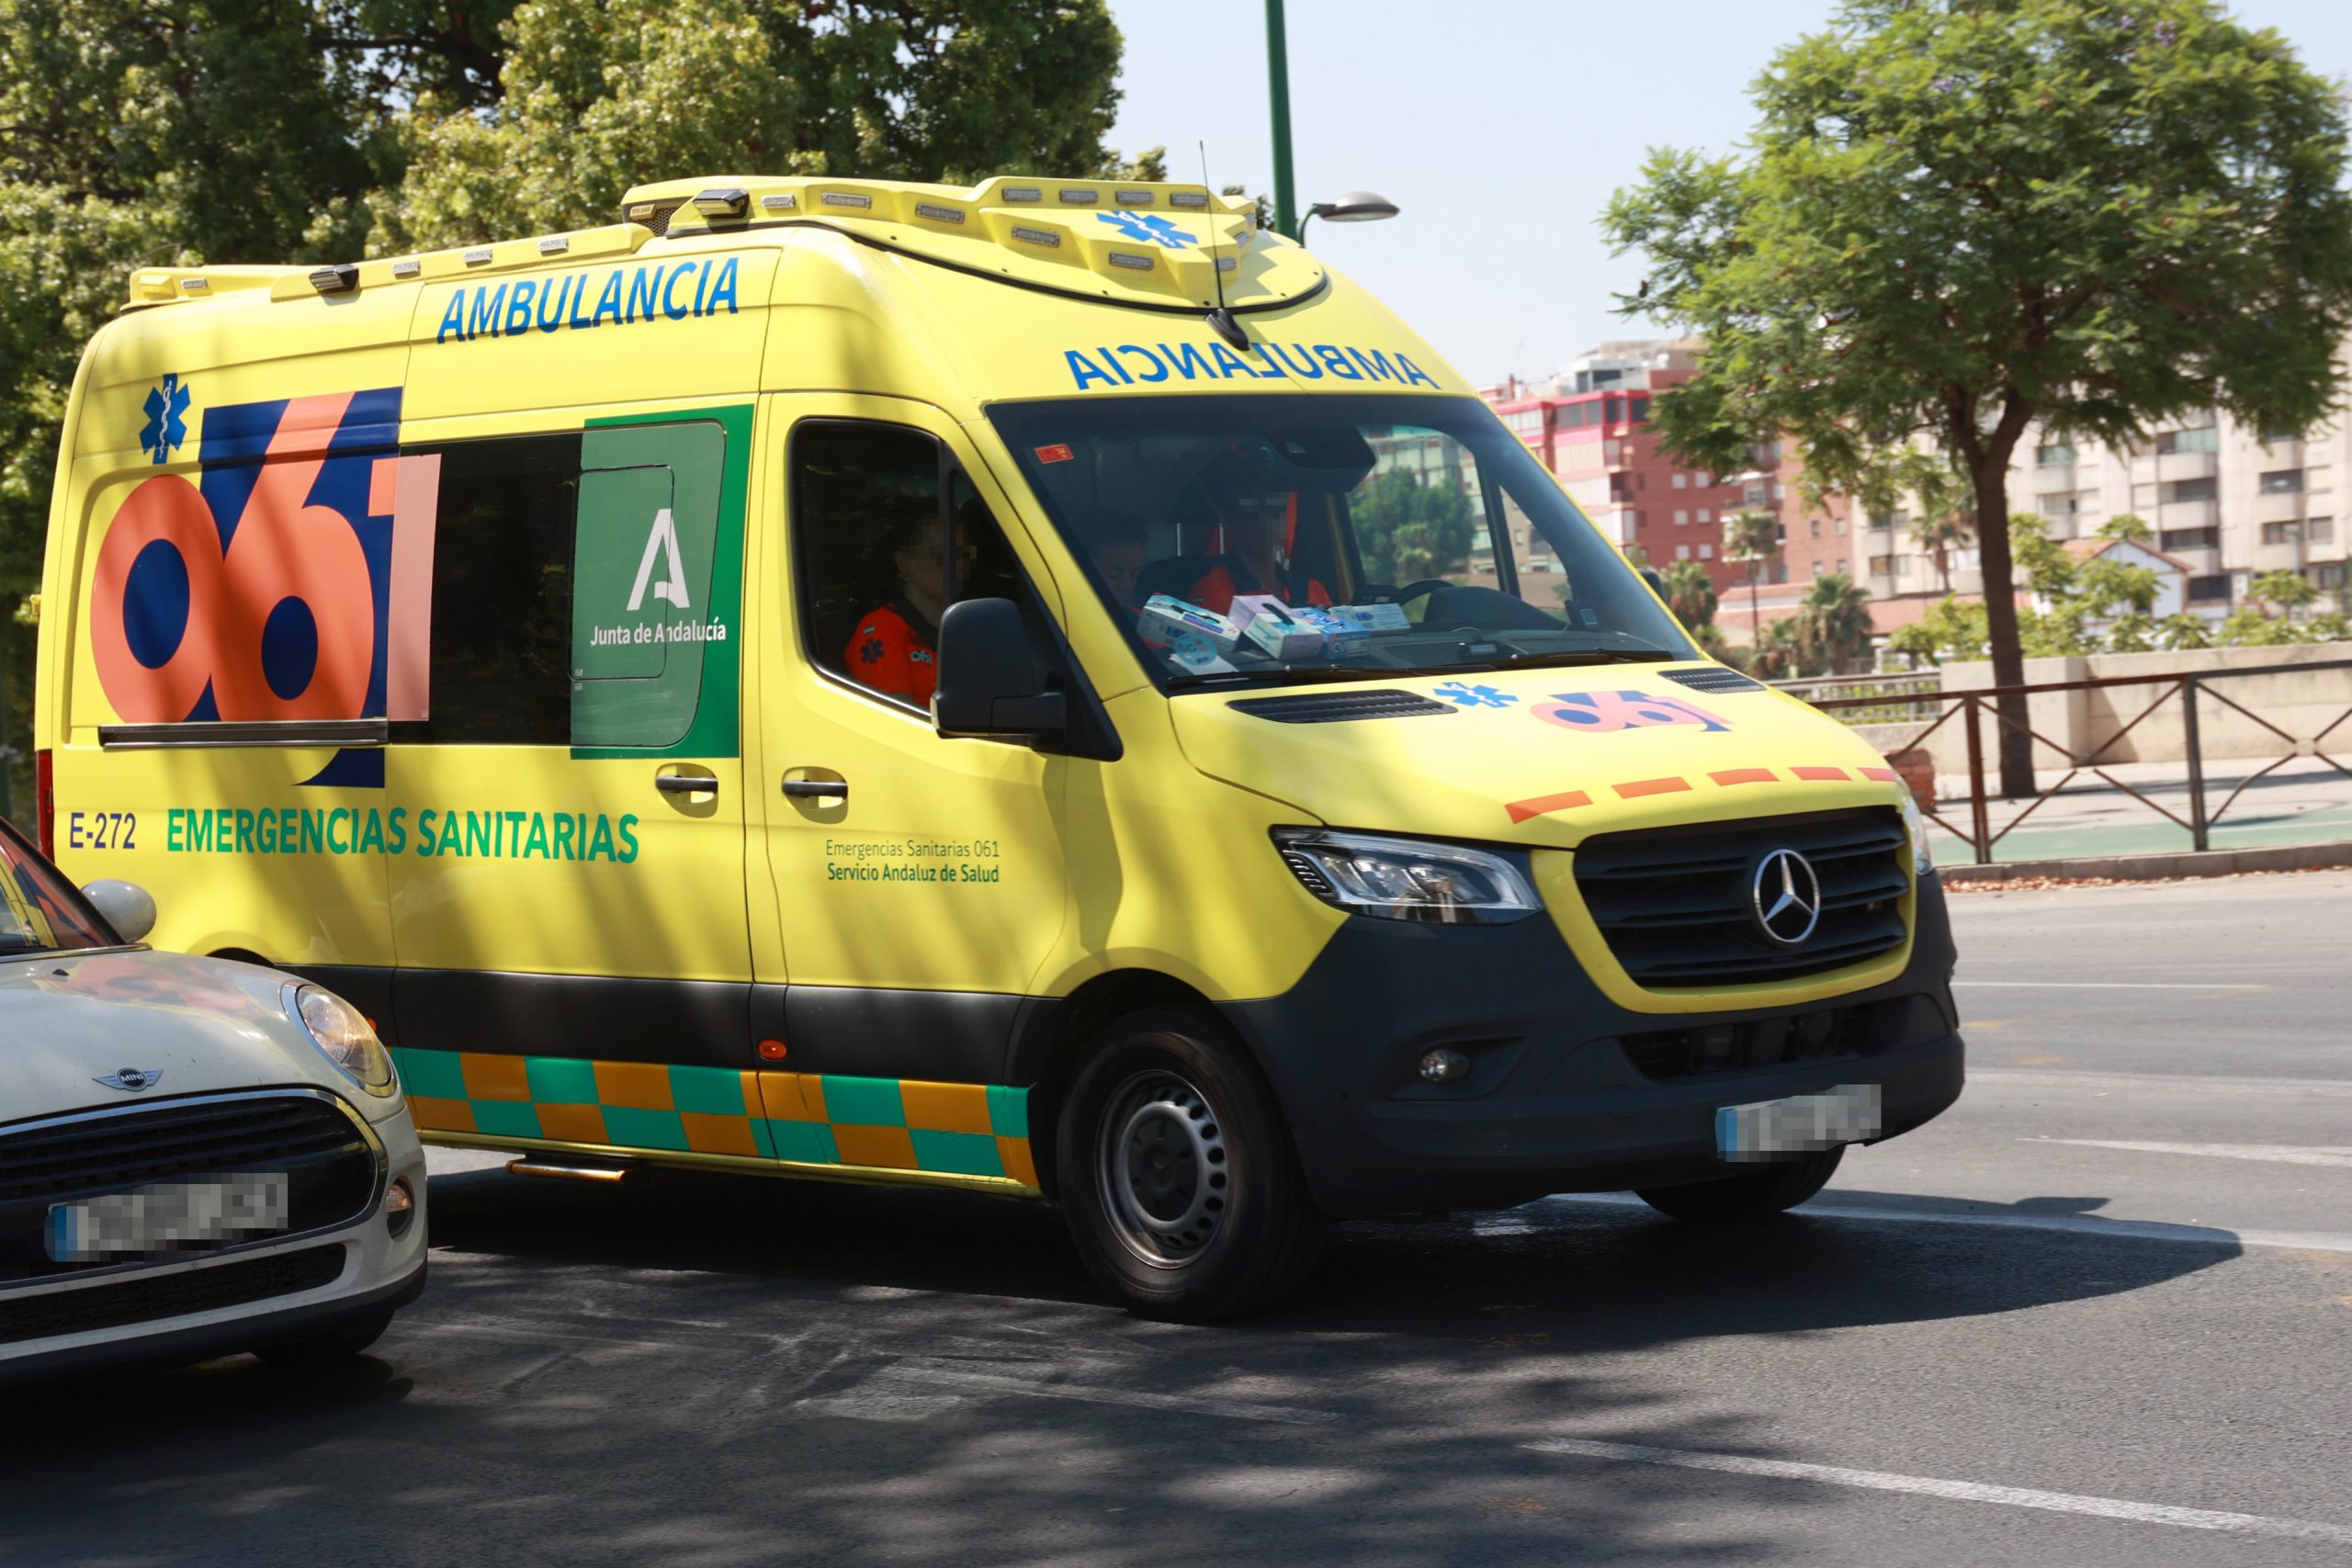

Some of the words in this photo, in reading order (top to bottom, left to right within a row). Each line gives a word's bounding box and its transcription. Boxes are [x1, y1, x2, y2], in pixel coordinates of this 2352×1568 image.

[436, 256, 739, 344] AMBULANCIA
[90, 392, 441, 723] 061
[590, 626, 630, 646] Junta
[634, 622, 652, 643] de
[654, 616, 726, 643] Andalucía
[1530, 690, 1735, 732] 061
[69, 812, 136, 849] E-272
[167, 807, 406, 855] EMERGENCIAS
[416, 810, 639, 863] SANITARIAS
[826, 840, 903, 860] Emergencias
[907, 840, 970, 857] Sanitarias
[974, 840, 1000, 857] 061
[828, 863, 879, 881] Servicio
[882, 863, 936, 882] Andaluz
[940, 864, 956, 882] de
[960, 864, 1000, 882] Salud
[120, 1073, 144, 1082] MINI
